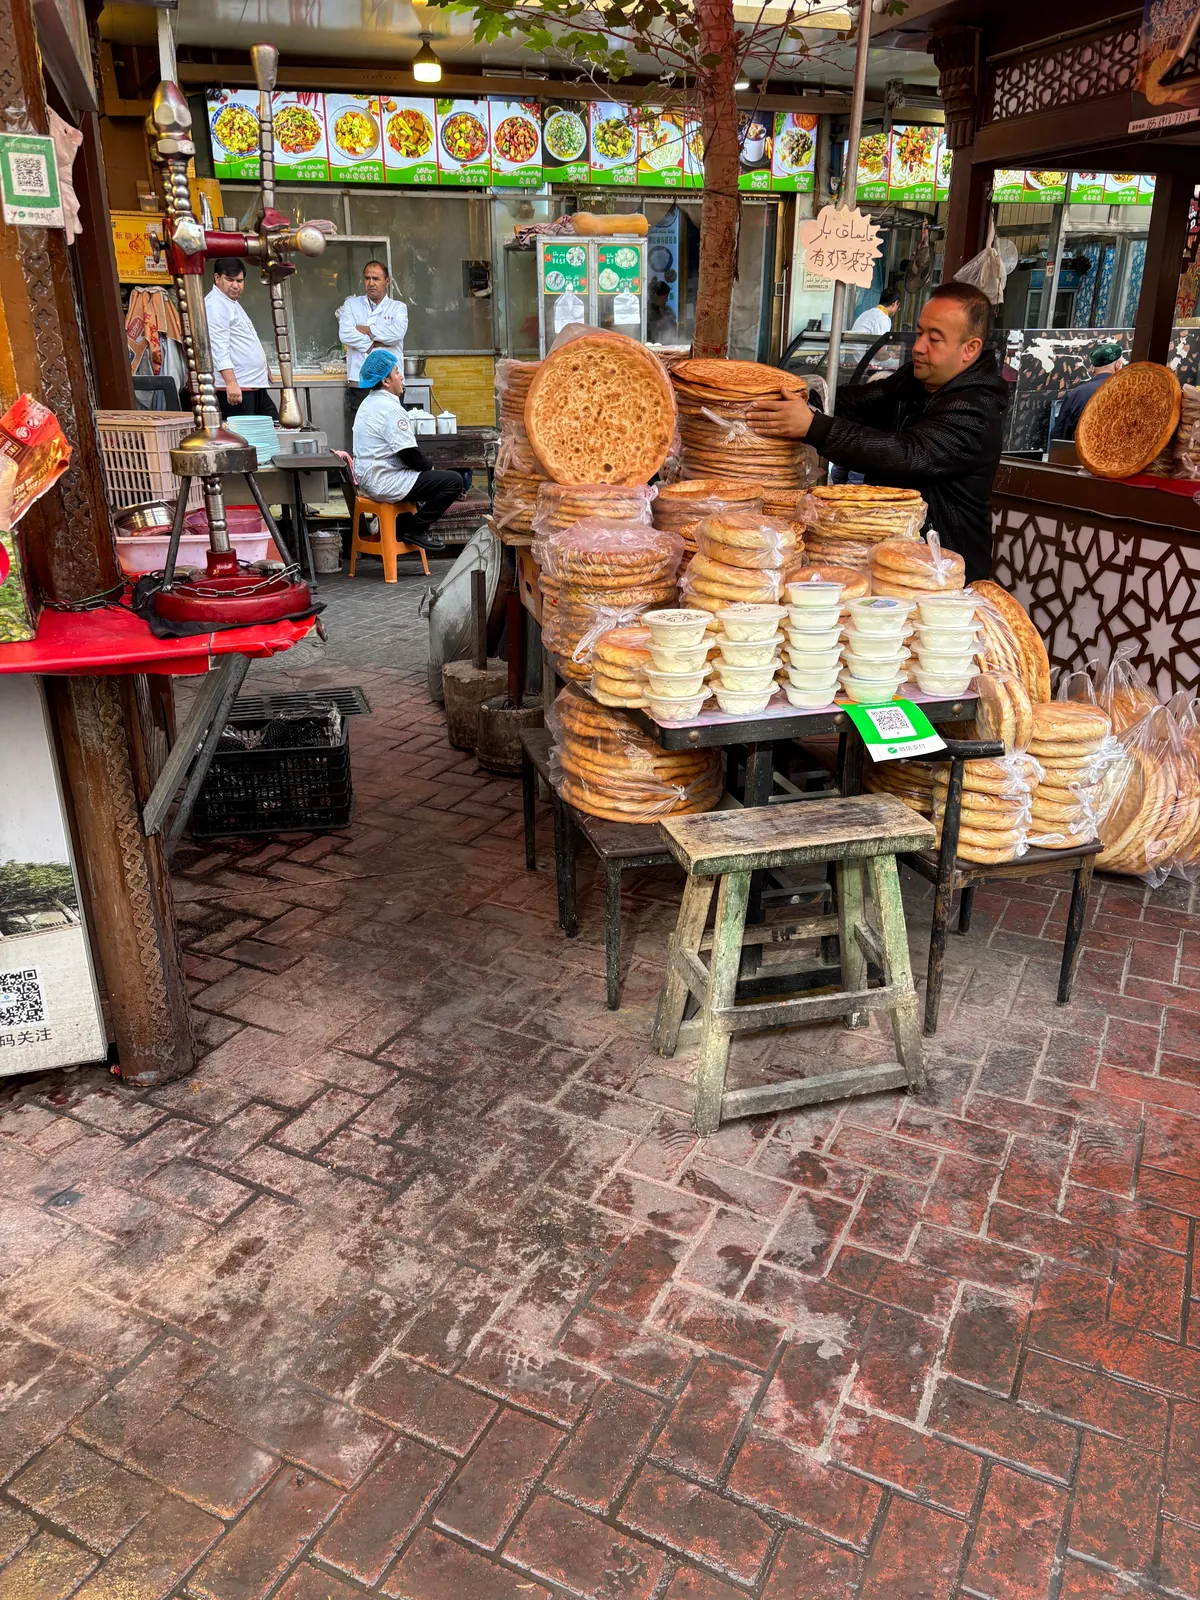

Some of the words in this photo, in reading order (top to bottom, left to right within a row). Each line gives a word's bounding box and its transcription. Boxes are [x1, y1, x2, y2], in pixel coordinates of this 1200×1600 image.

[810, 248, 875, 273] 有奶皮子
[0, 1027, 52, 1047] 码关注
